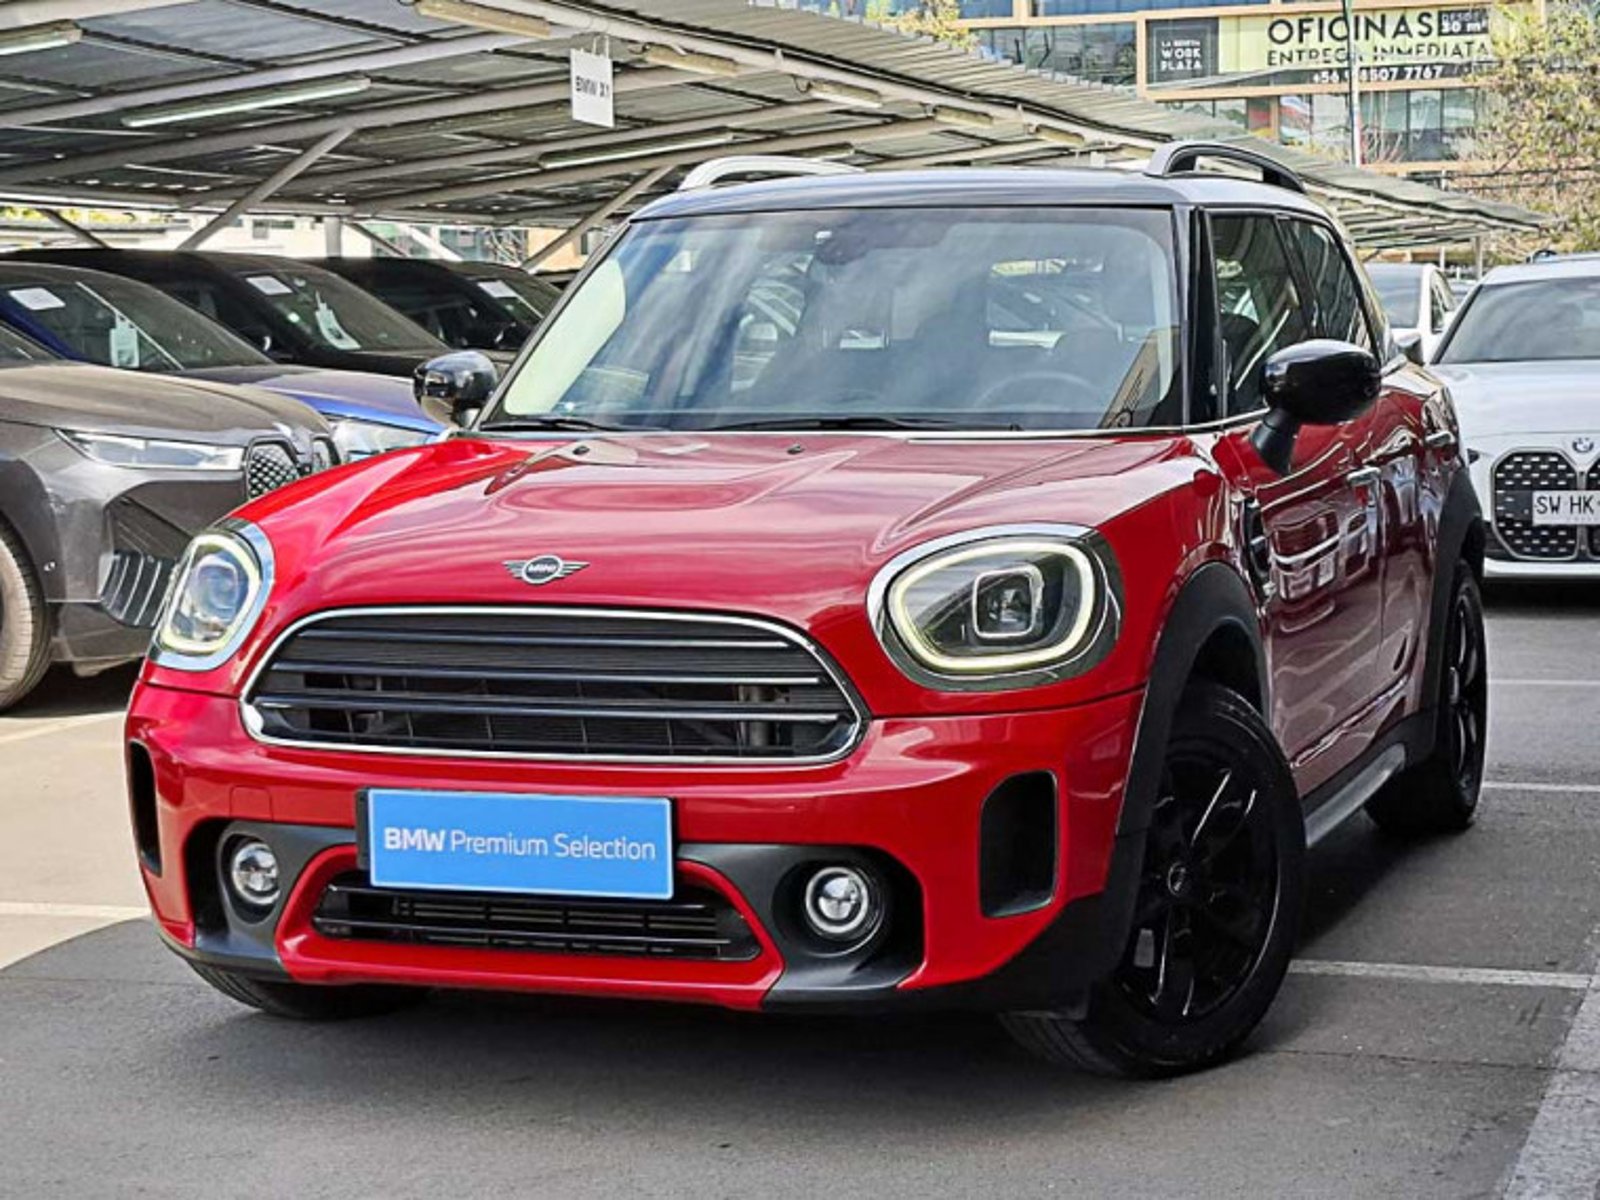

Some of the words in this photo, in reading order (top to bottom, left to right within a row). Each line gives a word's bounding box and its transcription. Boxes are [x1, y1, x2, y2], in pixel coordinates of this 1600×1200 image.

[1268, 11, 1433, 45] OFICINAS
[1161, 48, 1202, 60] WORK
[1160, 59, 1203, 72] PLAZA
[1404, 64, 1443, 80] 7767
[1536, 495, 1561, 515] SW
[1569, 494, 1595, 515] HK
[383, 826, 446, 852] BMW
[451, 828, 549, 858] Premium
[554, 832, 656, 861] Selection
